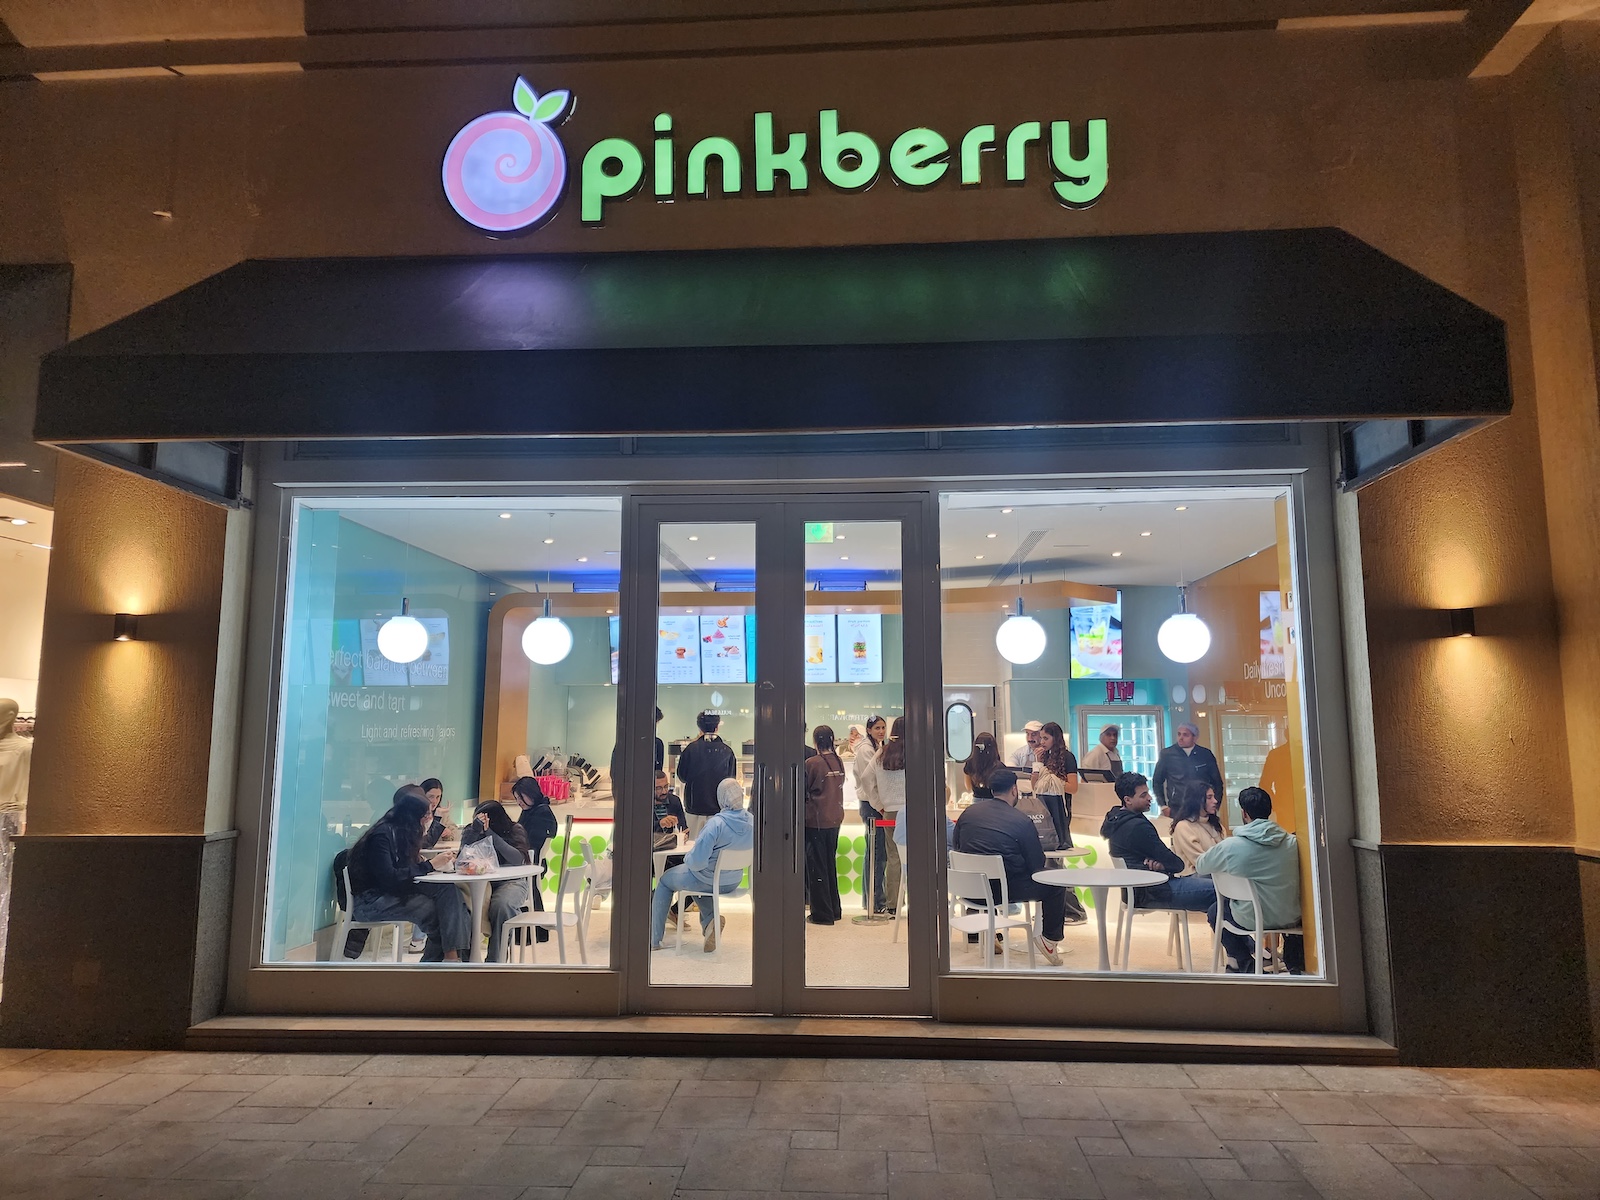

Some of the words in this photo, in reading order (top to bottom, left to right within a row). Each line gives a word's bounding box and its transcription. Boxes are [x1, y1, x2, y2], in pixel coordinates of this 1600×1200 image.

[580, 108, 1109, 224] pinkberry
[1243, 660, 1261, 683] Daily
[363, 690, 384, 710] and
[388, 692, 406, 711] tart
[361, 723, 382, 743] Light
[383, 723, 398, 738] and
[400, 724, 434, 742] refreshing
